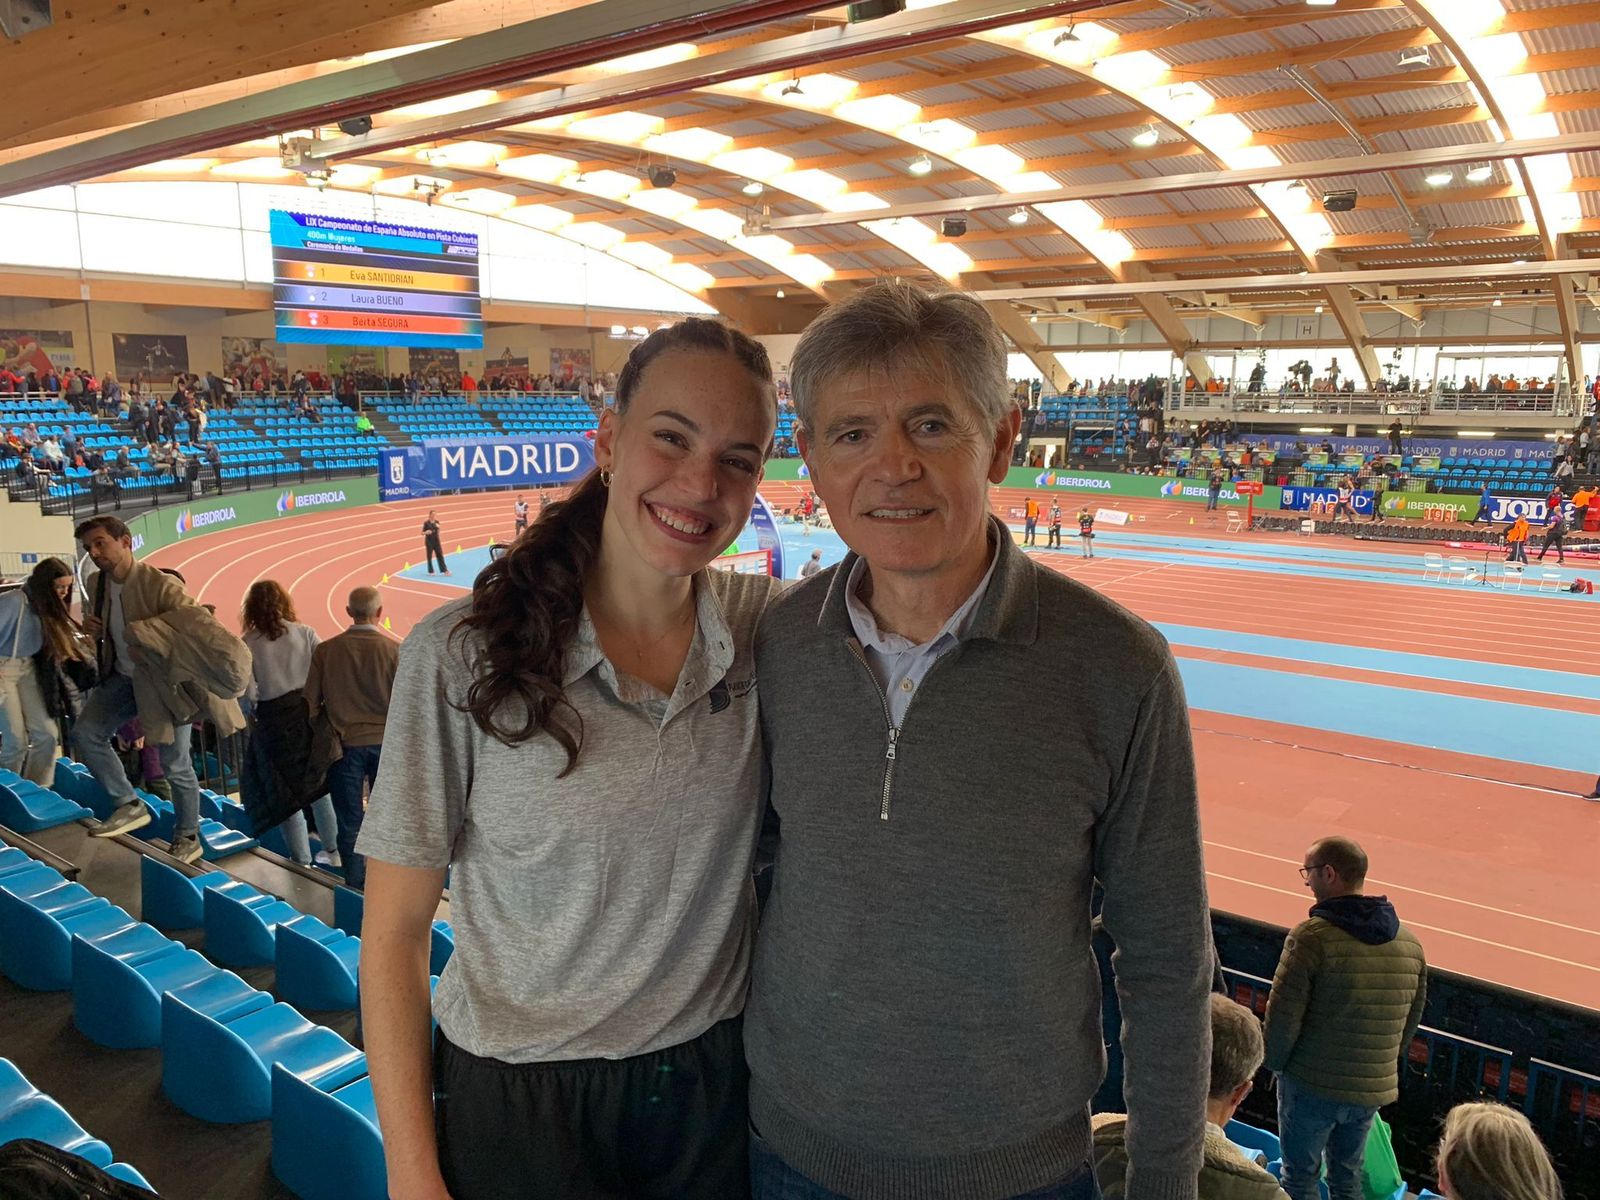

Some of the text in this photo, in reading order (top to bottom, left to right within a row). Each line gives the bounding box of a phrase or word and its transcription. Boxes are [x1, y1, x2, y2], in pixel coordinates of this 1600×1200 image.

[306, 217, 317, 226] LIX
[318, 219, 362, 232] Campeonato
[363, 224, 372, 233] de
[373, 225, 397, 236] España
[398, 228, 426, 239] Absoluto
[436, 232, 451, 242] Pista
[452, 234, 478, 244] Cubierta
[307, 231, 355, 244] 400m Mujeres
[350, 270, 365, 280] Eva
[321, 292, 404, 306] 2 Laura BUENO
[323, 315, 409, 328] 3 Berta SEGURA
[1303, 325, 1311, 335] H
[1462, 448, 1506, 457] MADRID
[441, 443, 579, 480] MADRID
[1056, 476, 1111, 489] IBERDROLA
[386, 487, 410, 496] MADRID
[295, 490, 346, 507] IBERDROLA
[1302, 492, 1367, 508] MADID
[192, 507, 236, 528] IBERDROLA
